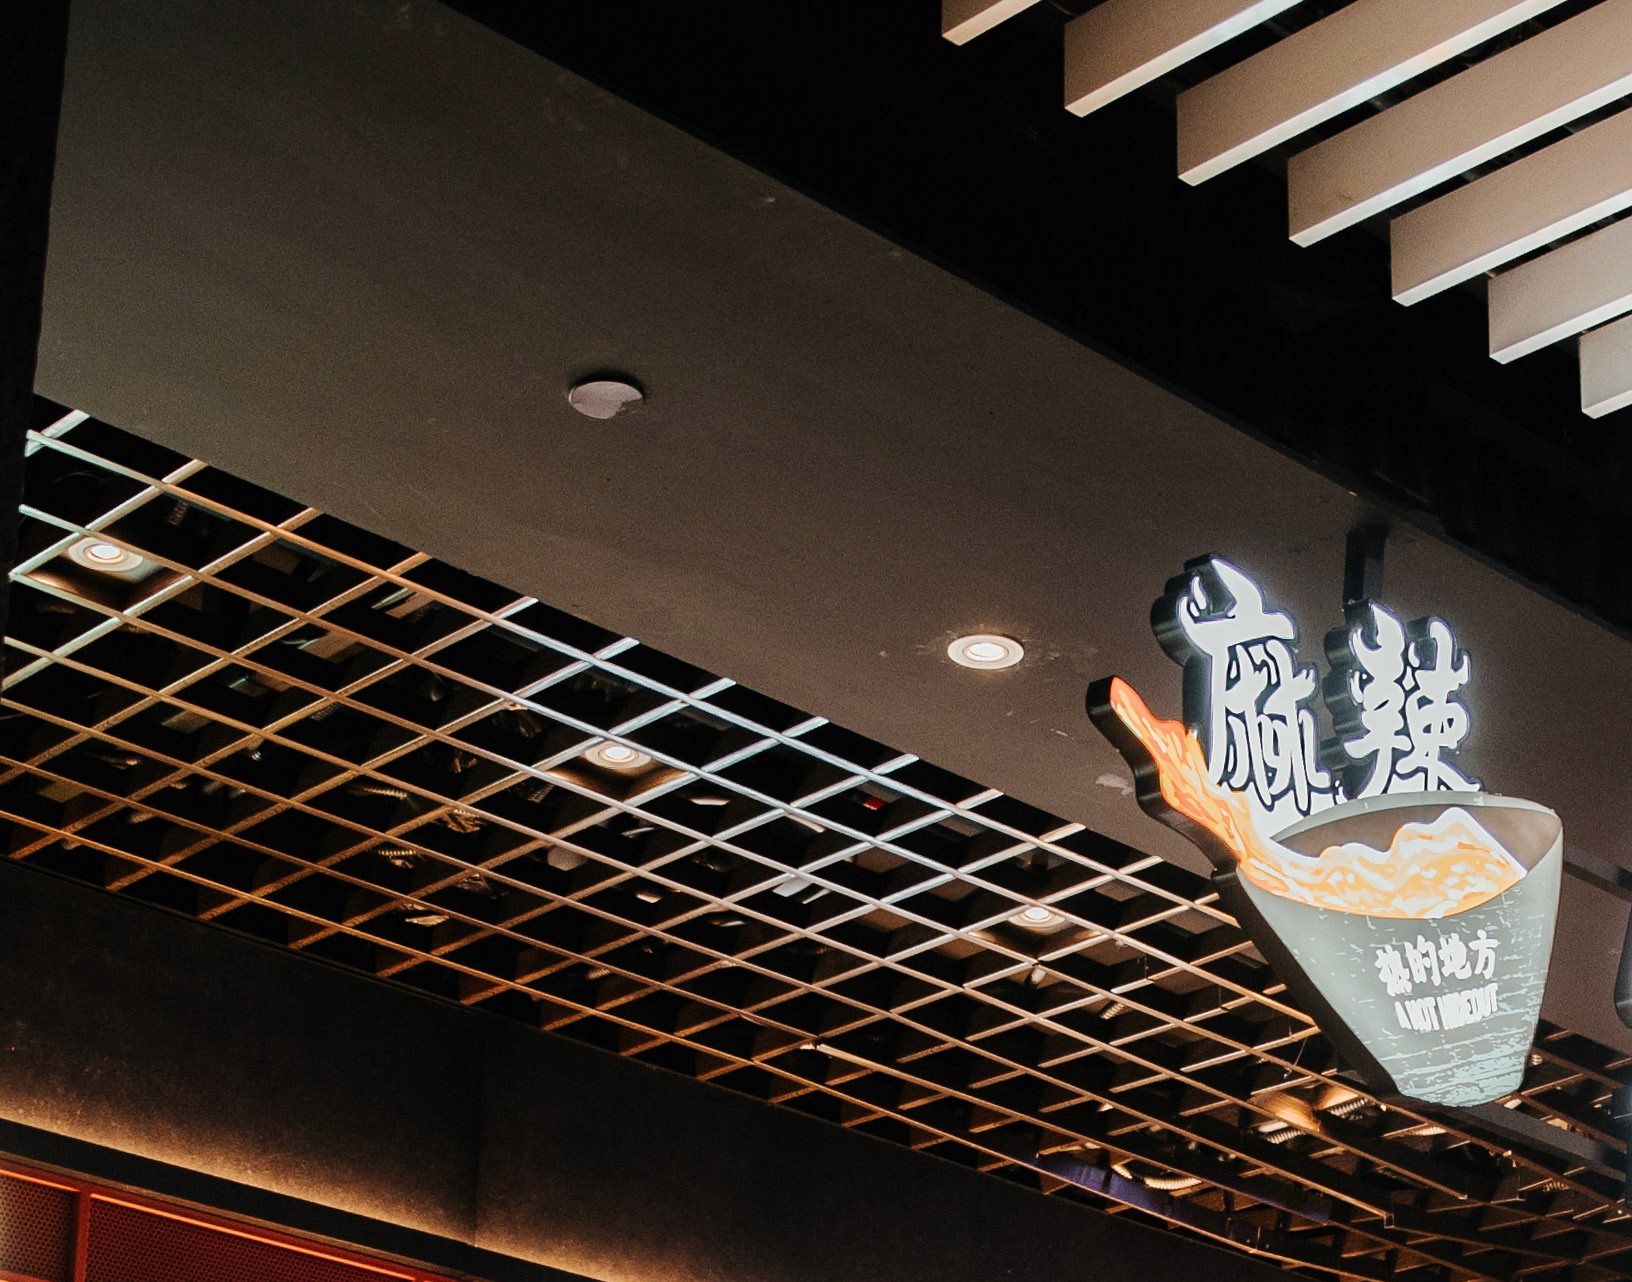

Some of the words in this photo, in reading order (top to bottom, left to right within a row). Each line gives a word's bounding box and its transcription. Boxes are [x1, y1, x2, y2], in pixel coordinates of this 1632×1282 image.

[1178, 558, 1480, 803] 麻辣
[1405, 997, 1439, 1031] HOT
[1437, 983, 1498, 1030] HIDEOUT
